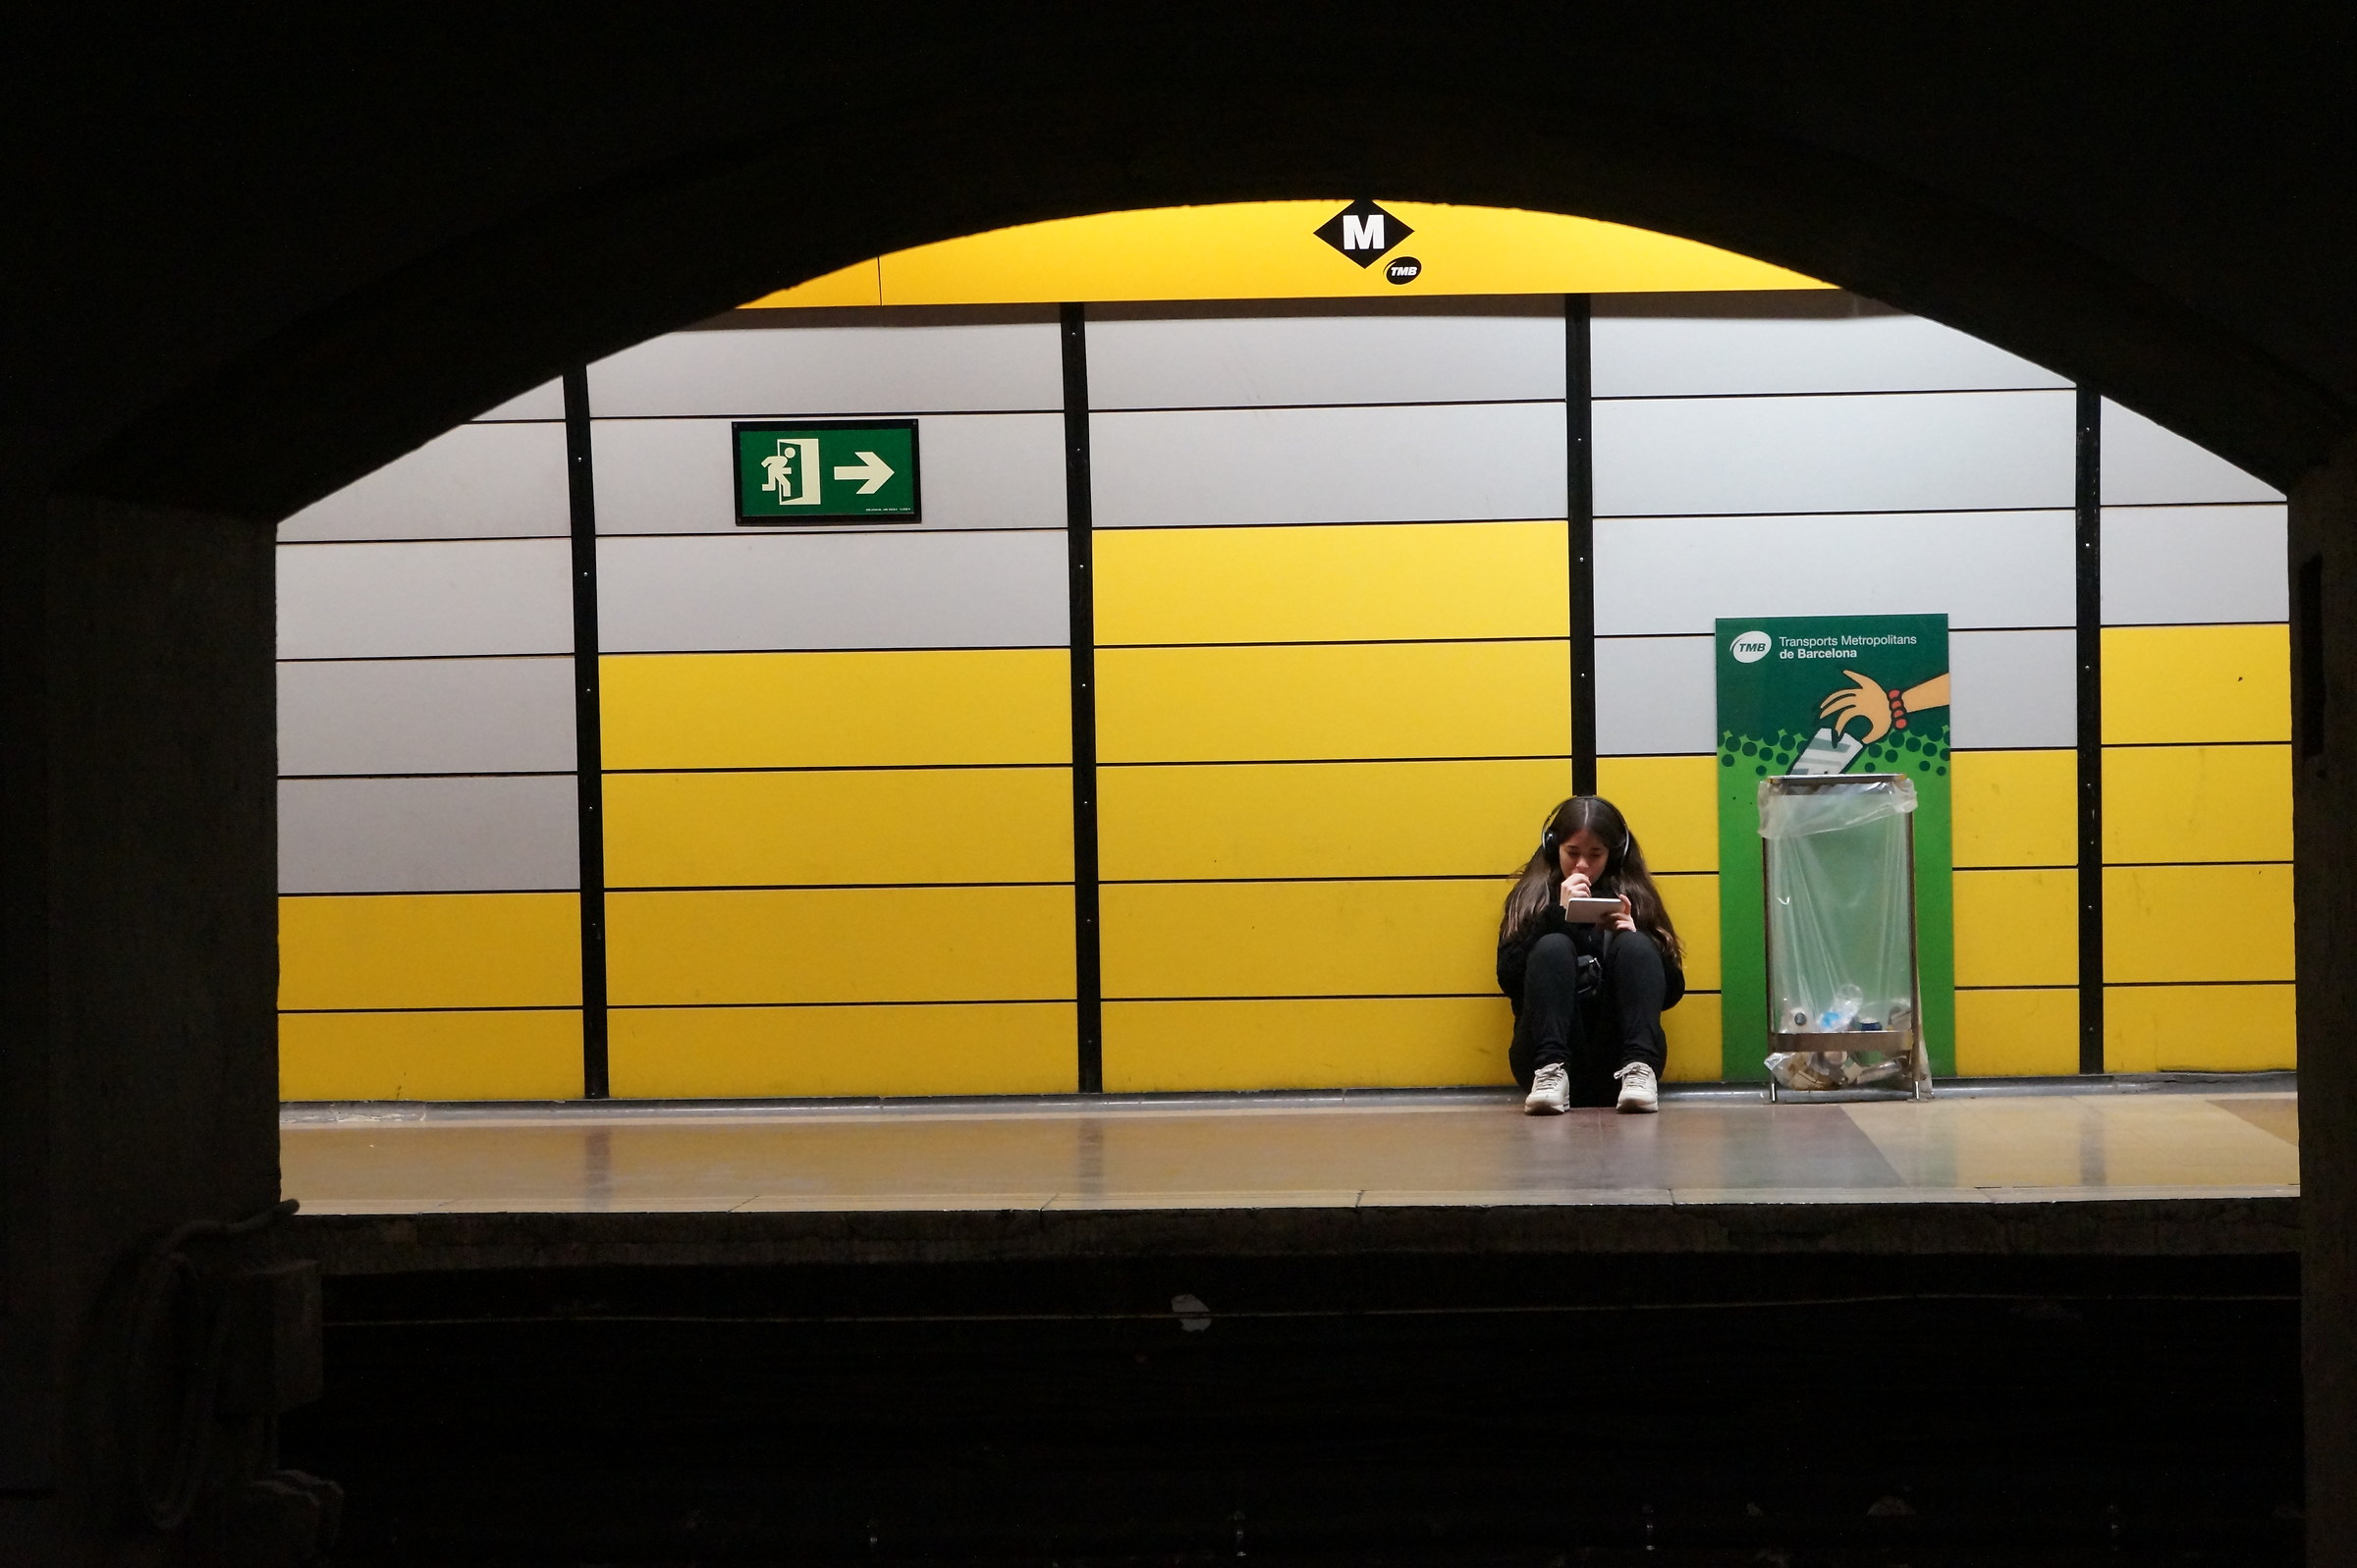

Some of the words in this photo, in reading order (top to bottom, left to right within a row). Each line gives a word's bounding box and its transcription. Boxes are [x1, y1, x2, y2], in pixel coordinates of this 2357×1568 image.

[1343, 214, 1385, 250] M
[1390, 266, 1418, 277] TMB
[1739, 642, 1767, 653] TMB
[1779, 636, 1838, 649] Transports
[1840, 634, 1917, 648] Metropolitans
[1779, 648, 1794, 660] de
[1797, 647, 1858, 659] Barcelona
